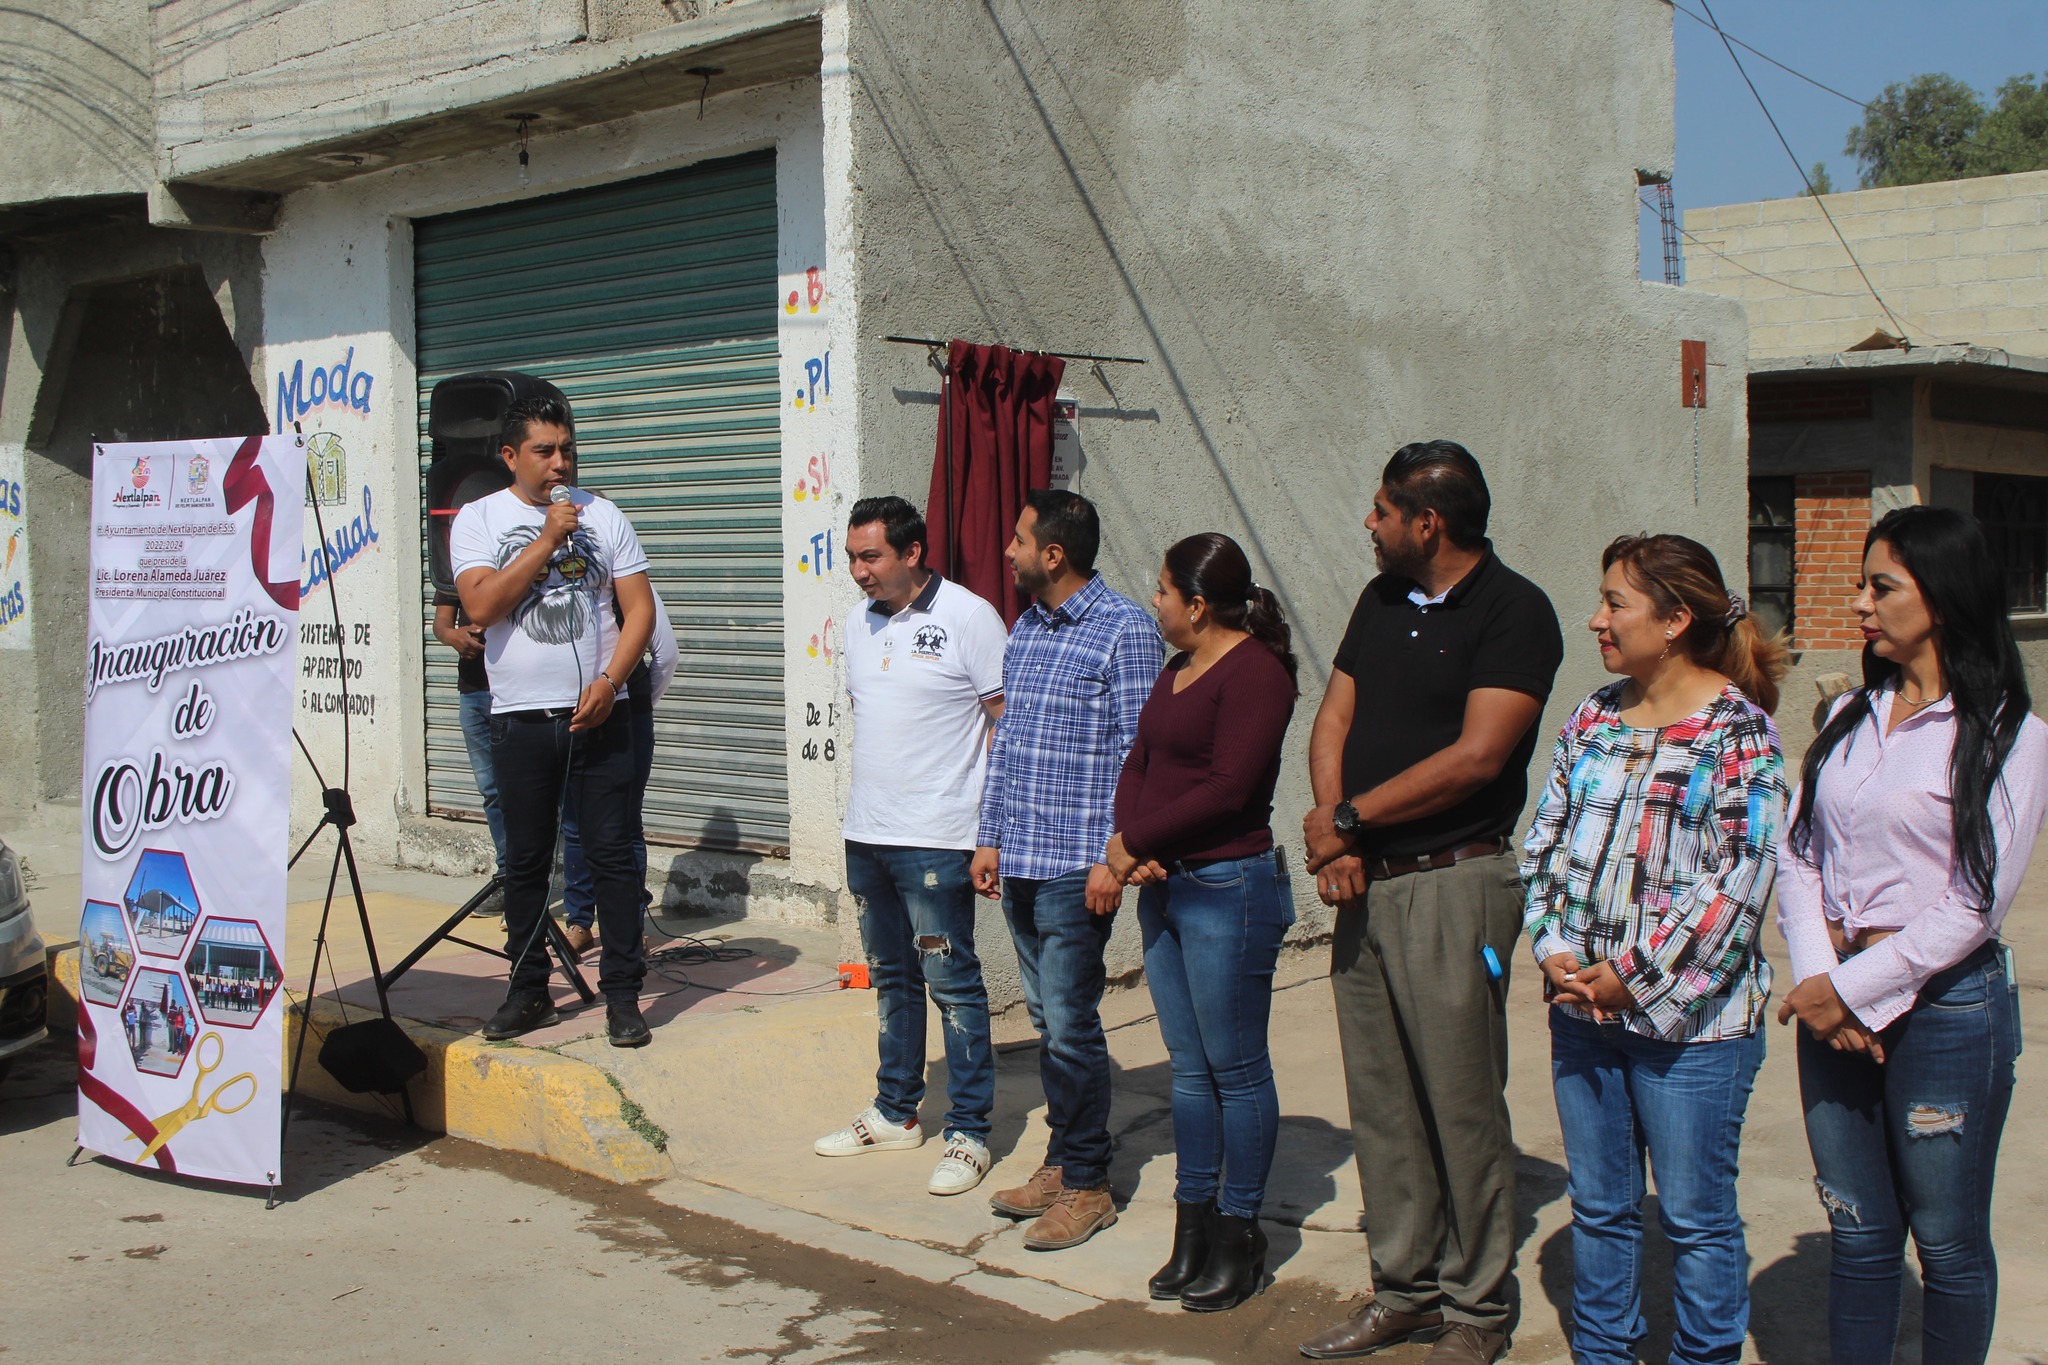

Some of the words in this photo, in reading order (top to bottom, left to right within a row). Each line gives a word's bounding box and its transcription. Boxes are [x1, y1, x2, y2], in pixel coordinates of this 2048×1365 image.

[277, 346, 374, 434] Moda
[112, 486, 160, 508] Nextlalpan
[105, 525, 156, 537] Ayuntamiento
[157, 525, 167, 534] de
[168, 524, 206, 537] Nextlalpan
[207, 524, 218, 533] de
[300, 485, 379, 597] asual
[145, 540, 183, 550] 2022-2024
[139, 558, 151, 568] que
[153, 556, 179, 568] preside
[180, 556, 187, 565] la
[97, 569, 111, 581] Lic.
[114, 569, 148, 581] Lorena
[151, 569, 192, 581] Alameda
[193, 569, 226, 581] Juárez
[95, 587, 134, 598] Presidenta
[136, 587, 171, 600] Municipal
[171, 587, 225, 598] Constitucional
[301, 623, 345, 645] SISTEMA
[354, 623, 370, 646] DE
[88, 610, 284, 698] Inauguración
[302, 656, 362, 679] APARTDO
[174, 684, 213, 734] de
[806, 702, 821, 727] De
[802, 738, 819, 761] de
[824, 738, 835, 761] 8
[93, 752, 231, 855] Obra
